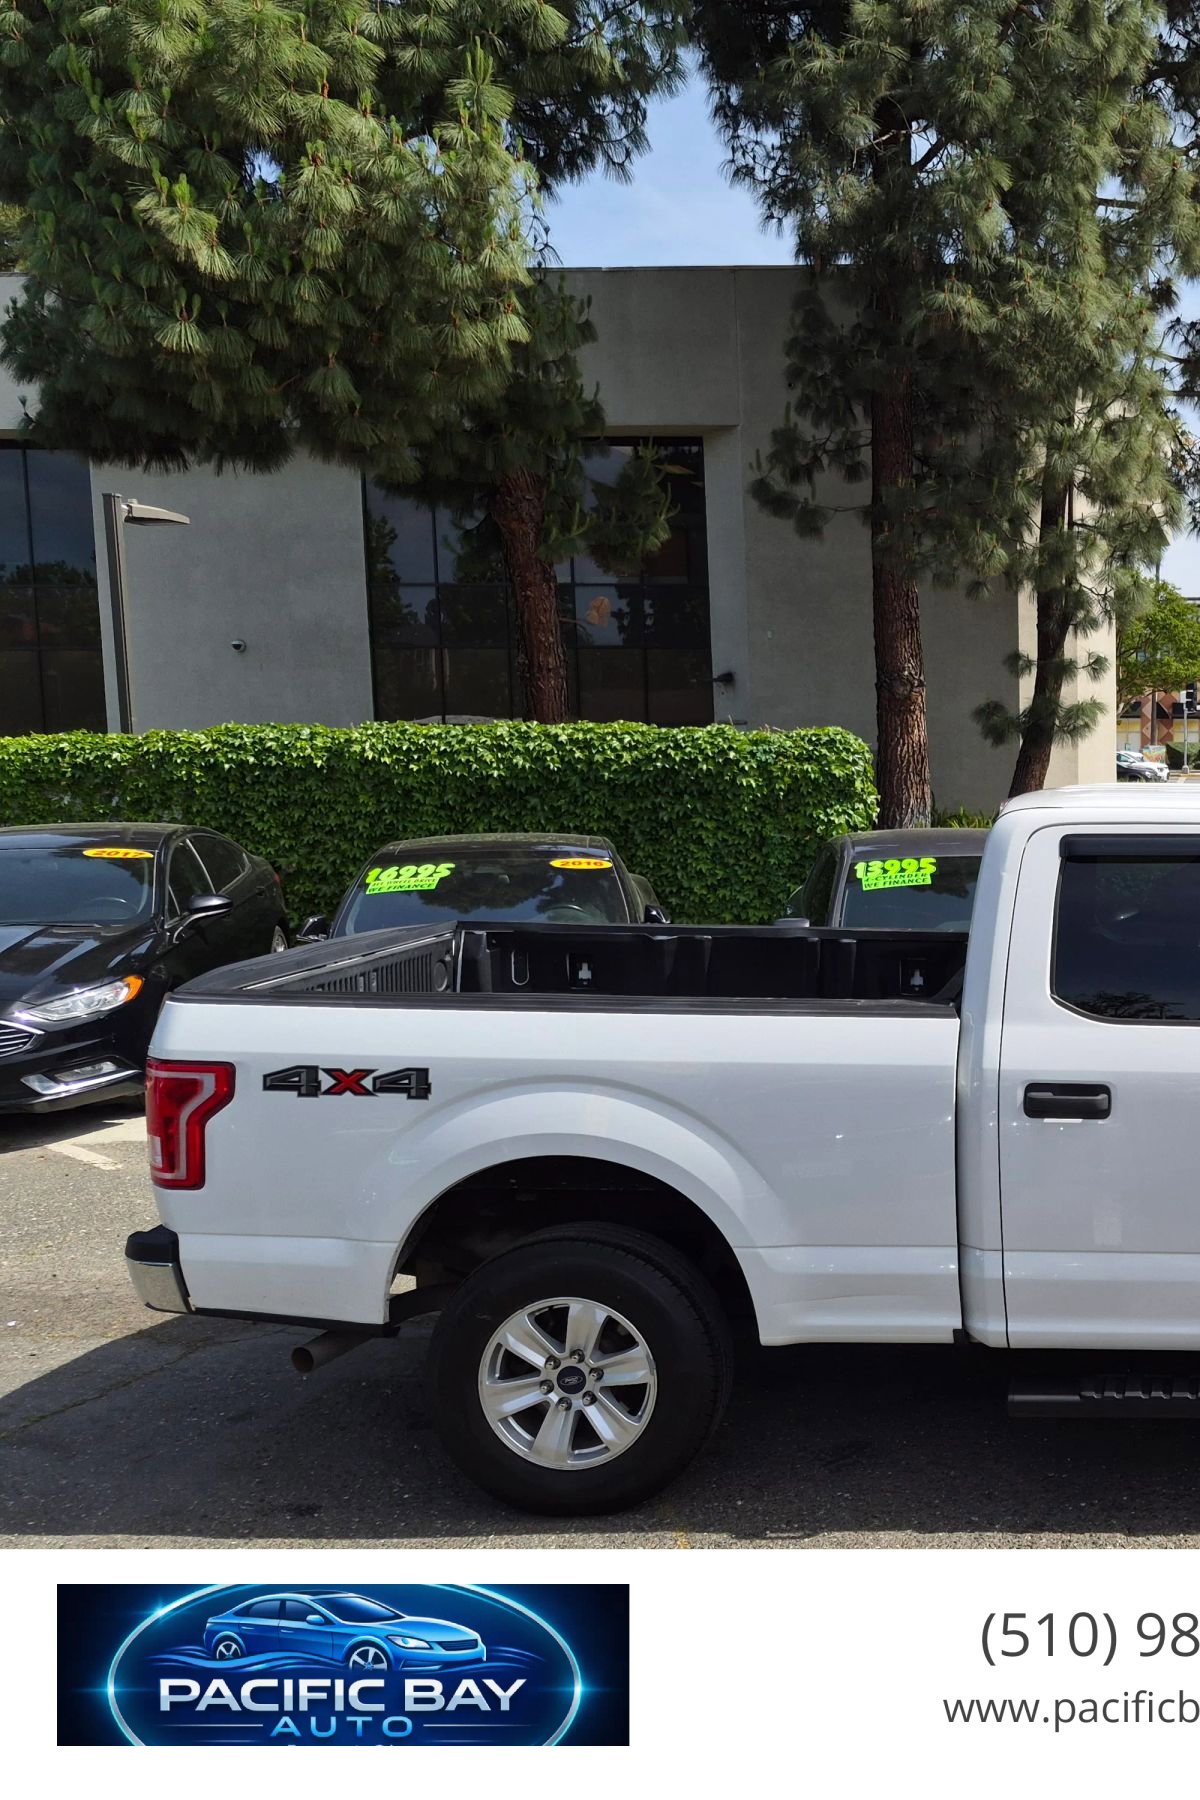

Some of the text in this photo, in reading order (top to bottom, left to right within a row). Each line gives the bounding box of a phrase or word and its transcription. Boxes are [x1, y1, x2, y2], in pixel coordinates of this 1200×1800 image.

[92, 849, 146, 858] 2017
[365, 862, 456, 884] 16995
[854, 857, 937, 879] 13995
[882, 877, 928, 887] FINANCE
